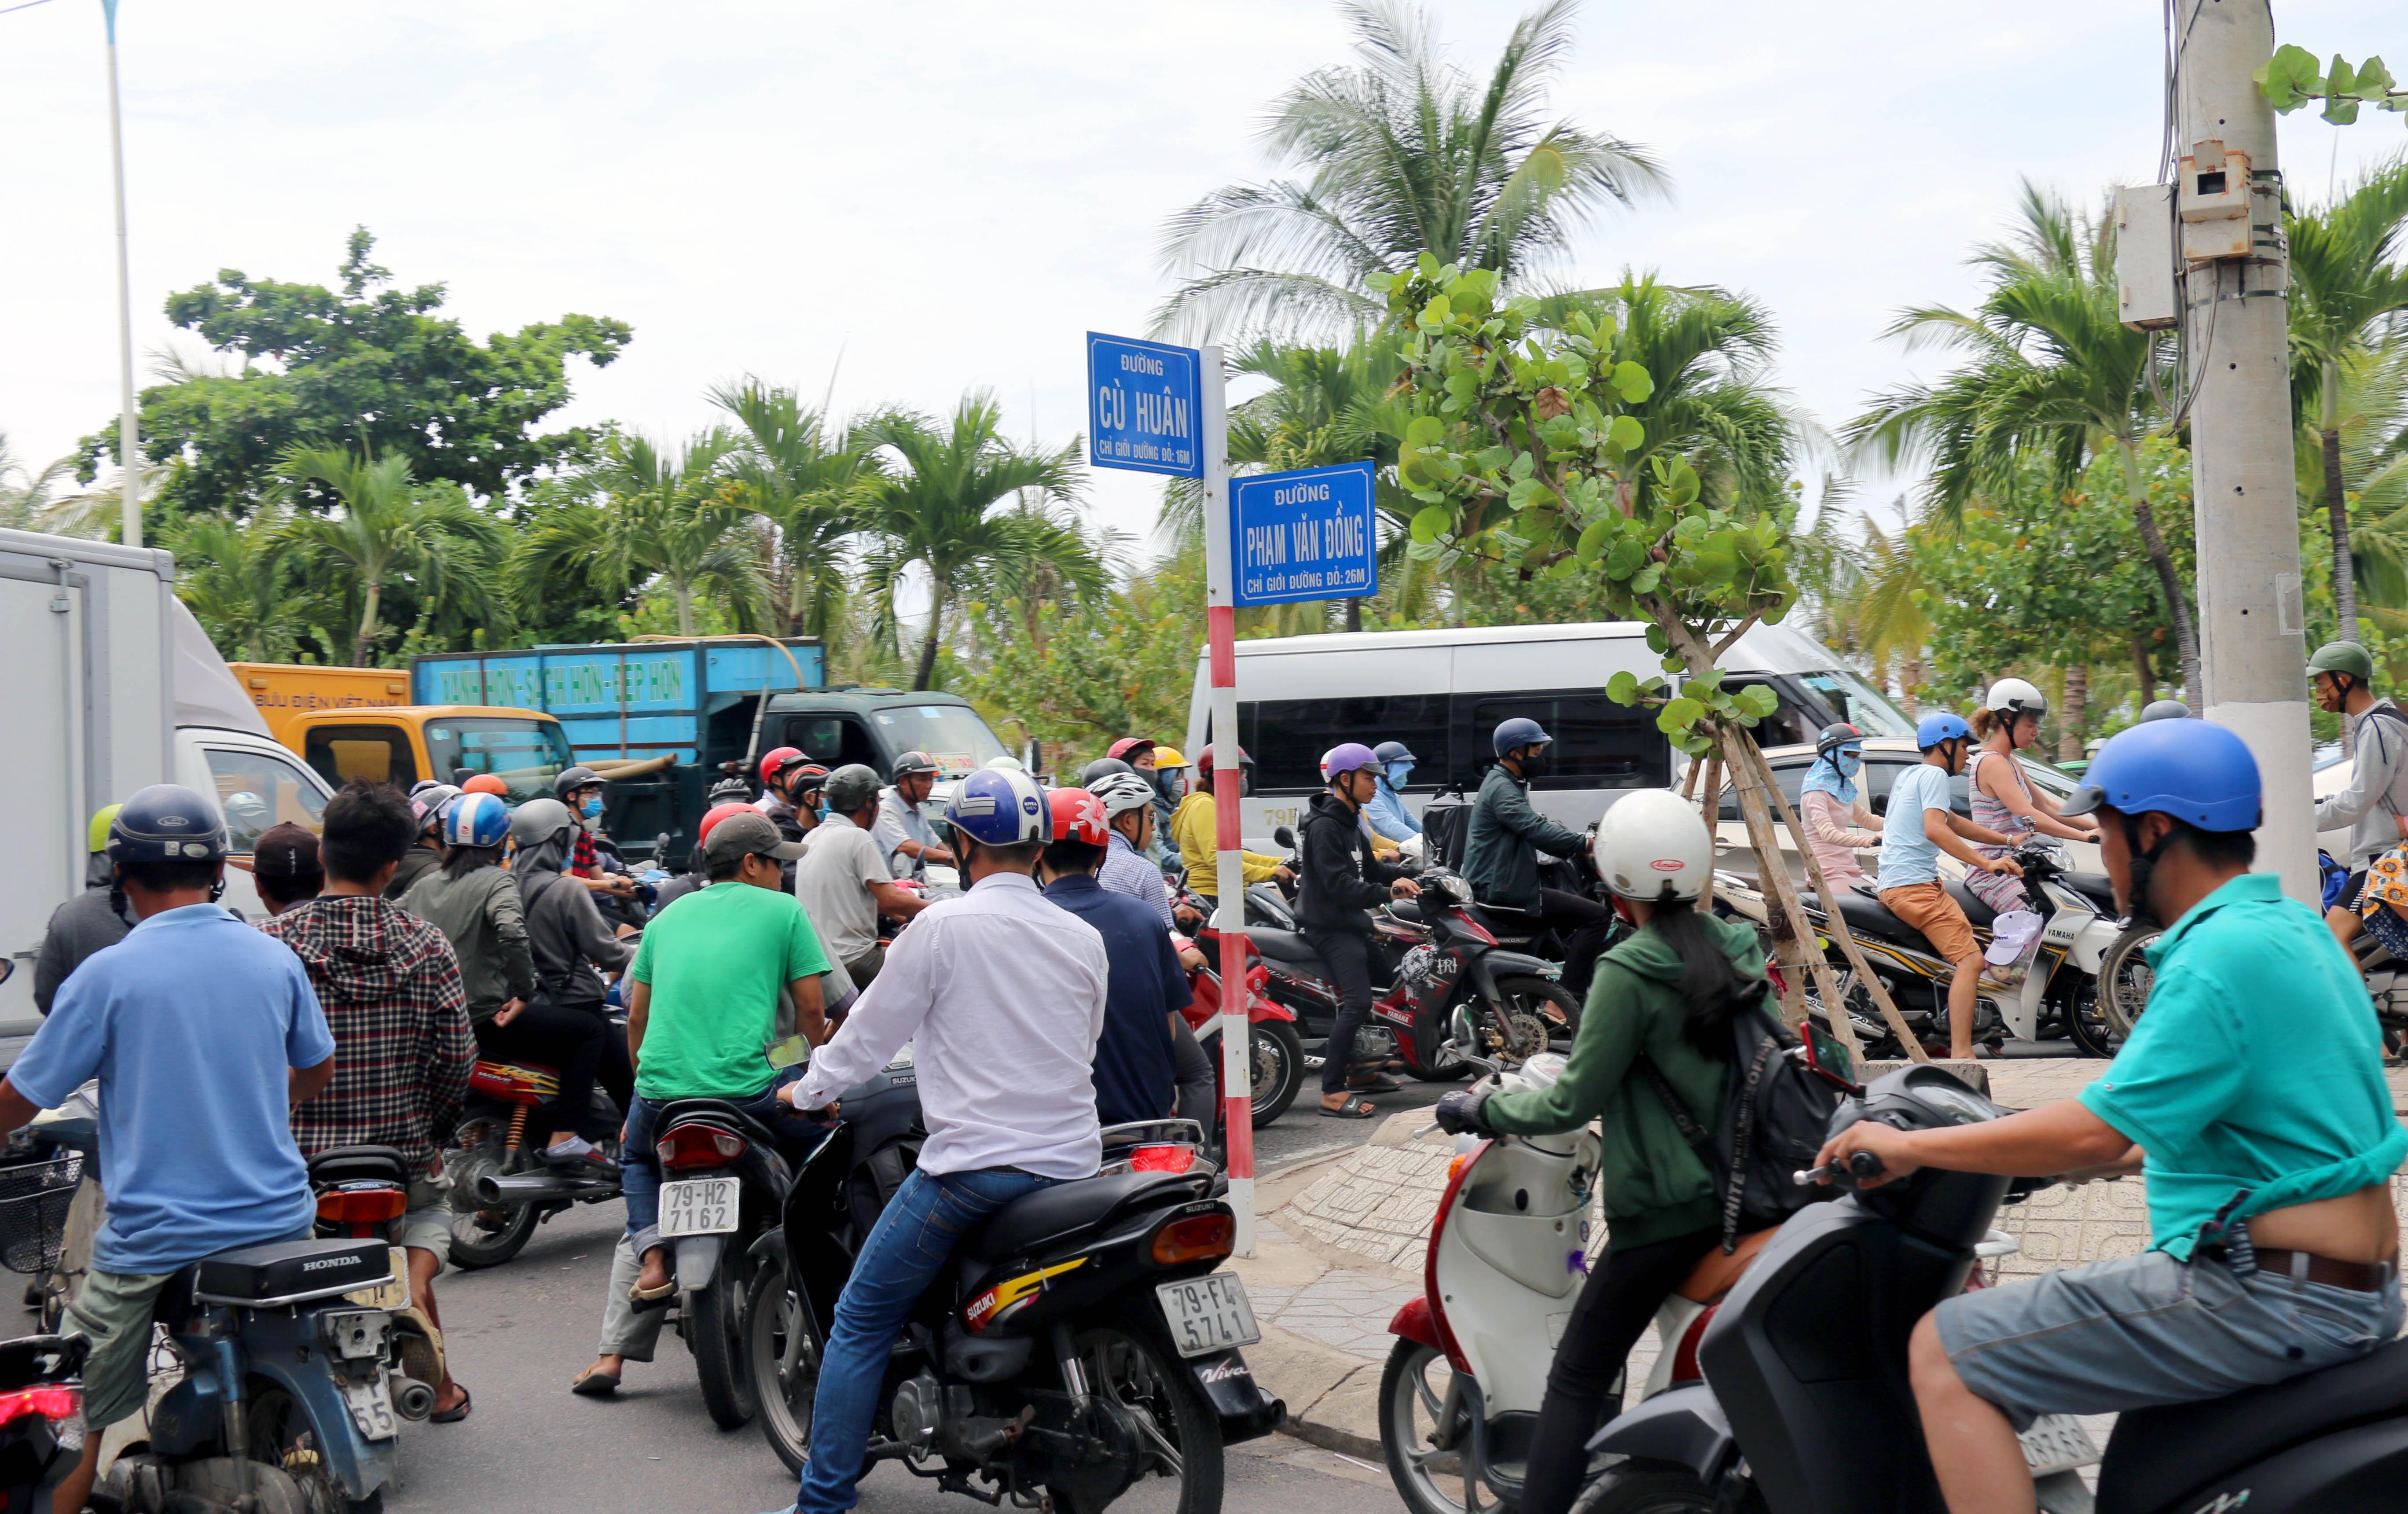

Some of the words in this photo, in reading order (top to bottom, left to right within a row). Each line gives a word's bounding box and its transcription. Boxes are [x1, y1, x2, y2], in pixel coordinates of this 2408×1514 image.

[1121, 354, 1163, 376] ĐƯỜNG
[1100, 378, 1126, 430] CÙ
[1135, 386, 1188, 438] HUÂN
[1099, 435, 1112, 454] CHỈ
[1115, 439, 1129, 457] GIỚI
[1133, 441, 1159, 460] ĐƯỜNG
[1162, 442, 1175, 463] ĐỎ:
[1176, 450, 1190, 465] 16M
[1274, 483, 1329, 506] ĐƯỜNG
[1247, 524, 1286, 570] PHẠM
[1293, 514, 1319, 562] VĂN
[1325, 501, 1363, 559] ĐỒNG
[1247, 574, 1263, 593] CHỈ
[1266, 572, 1285, 592] GIỚI
[1289, 569, 1322, 589] ĐƯỜNG
[1327, 566, 1343, 585] ĐỎ:
[1345, 568, 1365, 584] 26M
[2048, 928, 2074, 941] YAMAHA
[1387, 1010, 1409, 1024] YAMAHA
[672, 1183, 727, 1208] 79-H2
[1186, 1203, 1214, 1213] SUZUKI
[670, 1207, 725, 1231] 7162
[303, 1255, 362, 1271] HONDA
[967, 1292, 996, 1321] SUZUKI
[1183, 1310, 1247, 1349] 5741
[1200, 1358, 1250, 1383] Viva
